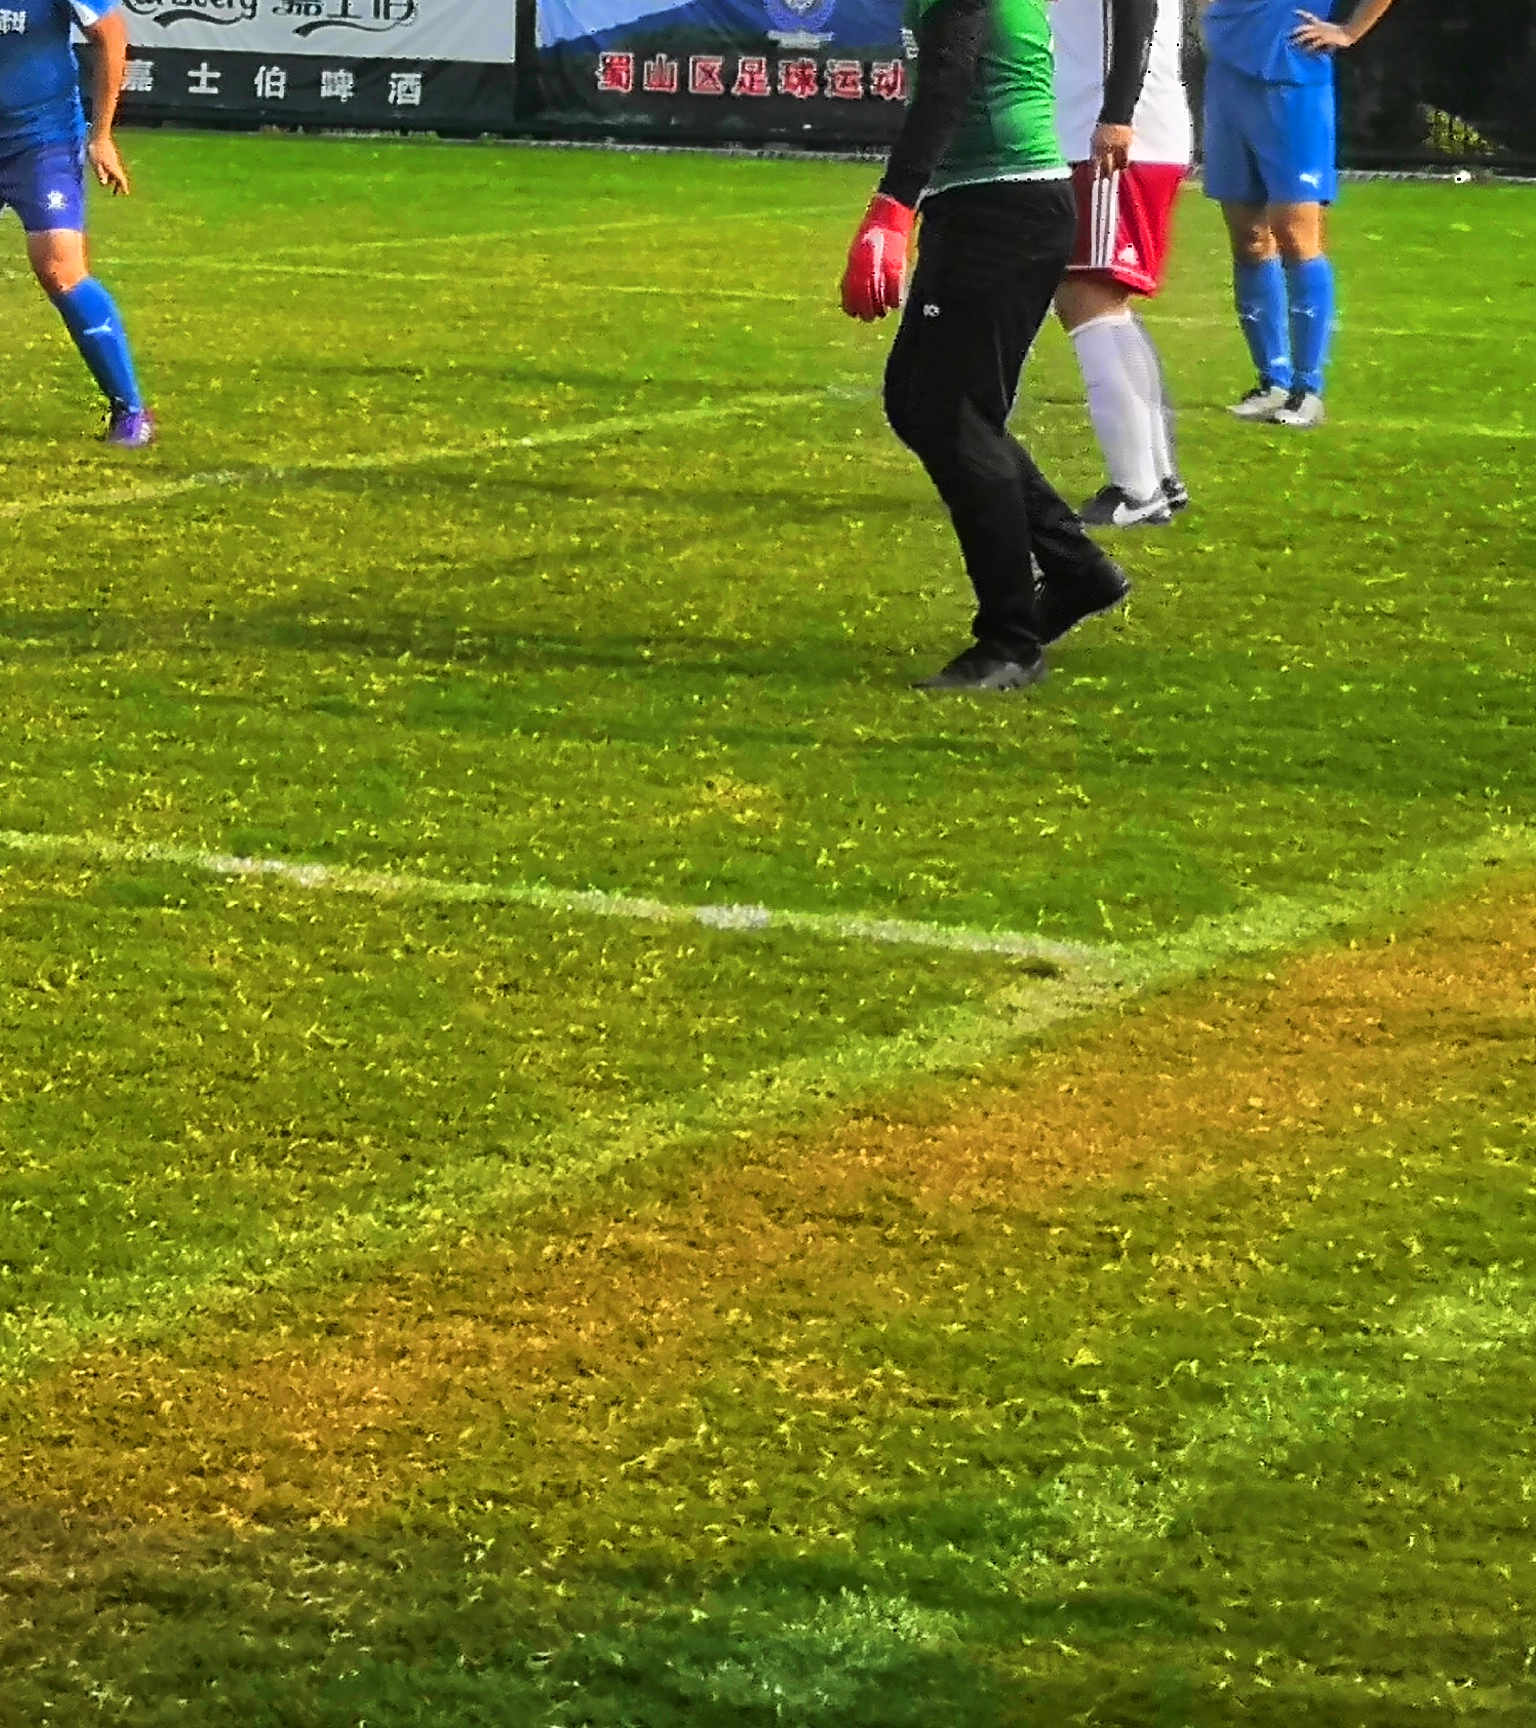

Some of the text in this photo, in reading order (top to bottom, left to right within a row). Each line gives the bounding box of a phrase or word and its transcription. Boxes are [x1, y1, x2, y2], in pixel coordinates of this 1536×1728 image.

[121, 59, 424, 106] 嘉士伯啤酒
